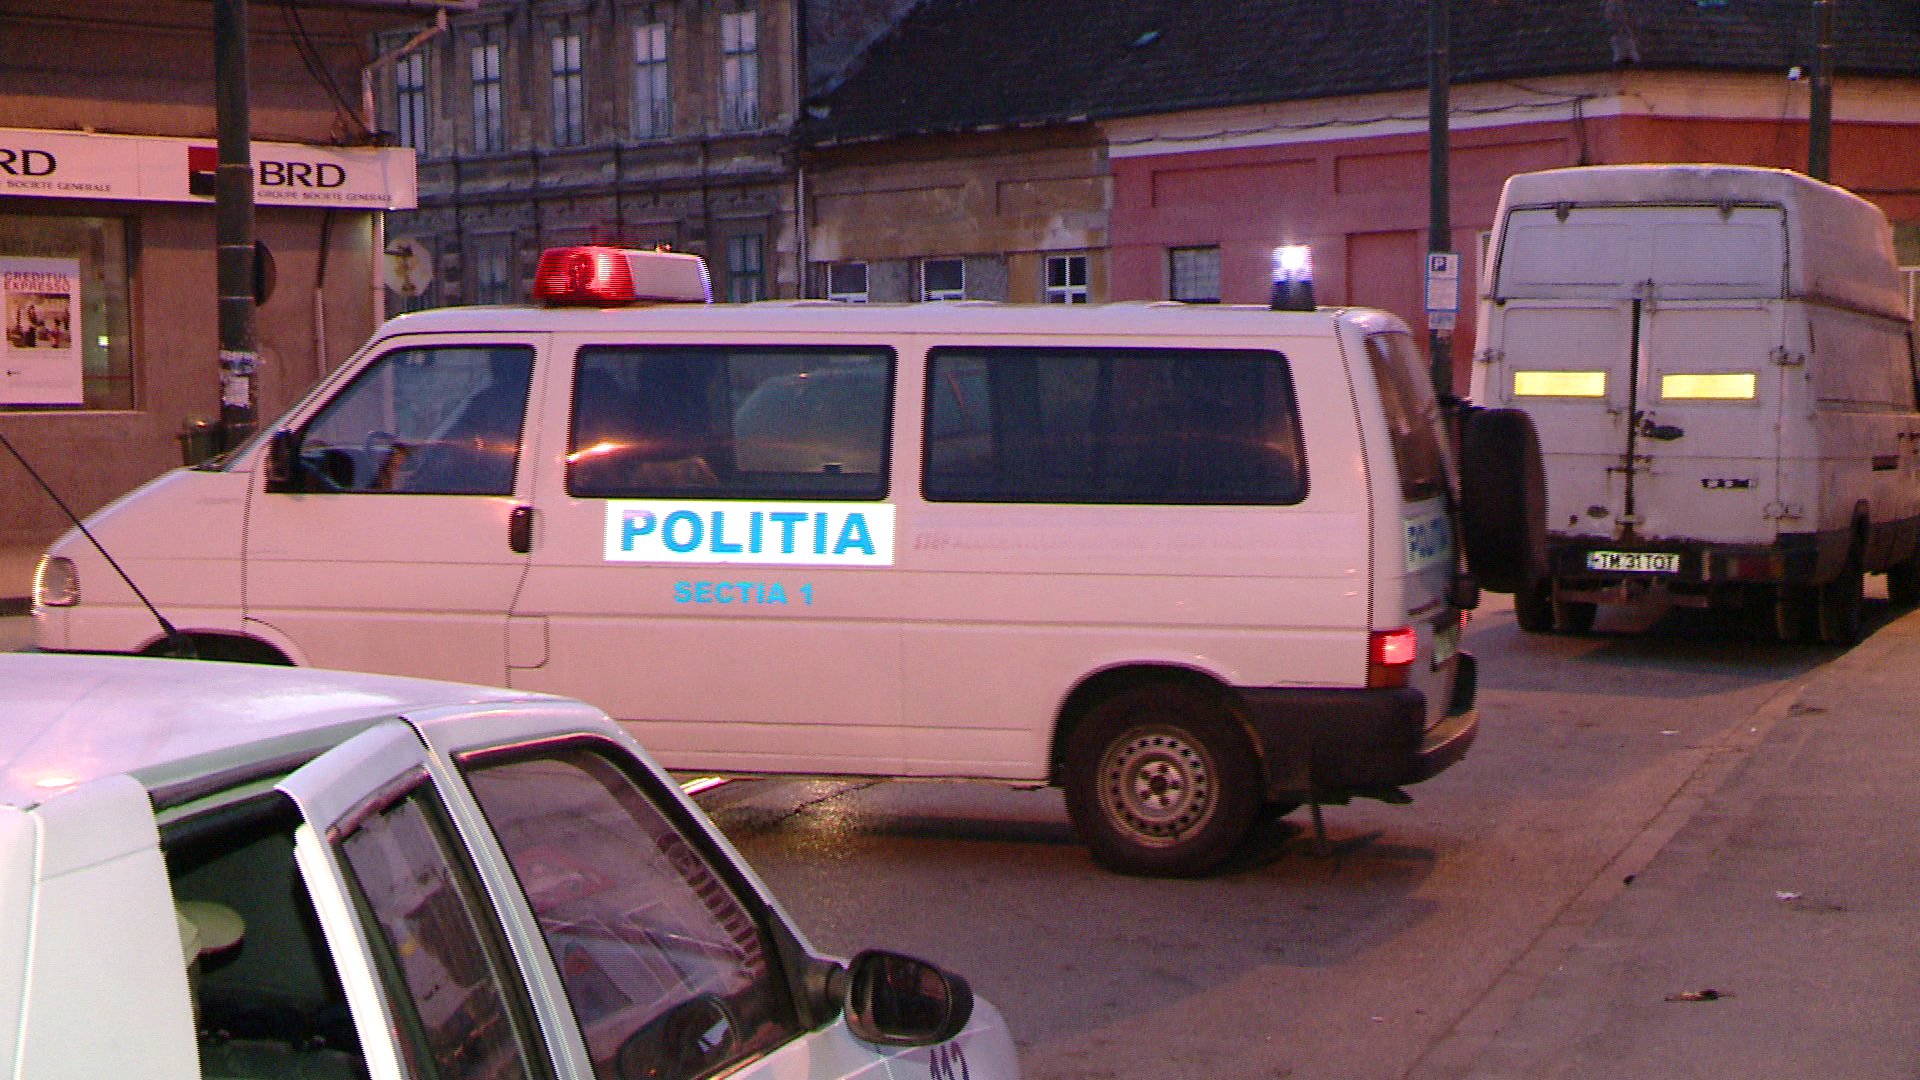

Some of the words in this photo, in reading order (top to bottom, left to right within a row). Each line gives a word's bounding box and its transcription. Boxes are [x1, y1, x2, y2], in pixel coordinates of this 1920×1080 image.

[259, 161, 346, 188] BRD
[620, 509, 877, 555] POLITIA
[673, 581, 788, 605] SECTIA
[799, 581, 814, 605] 1
